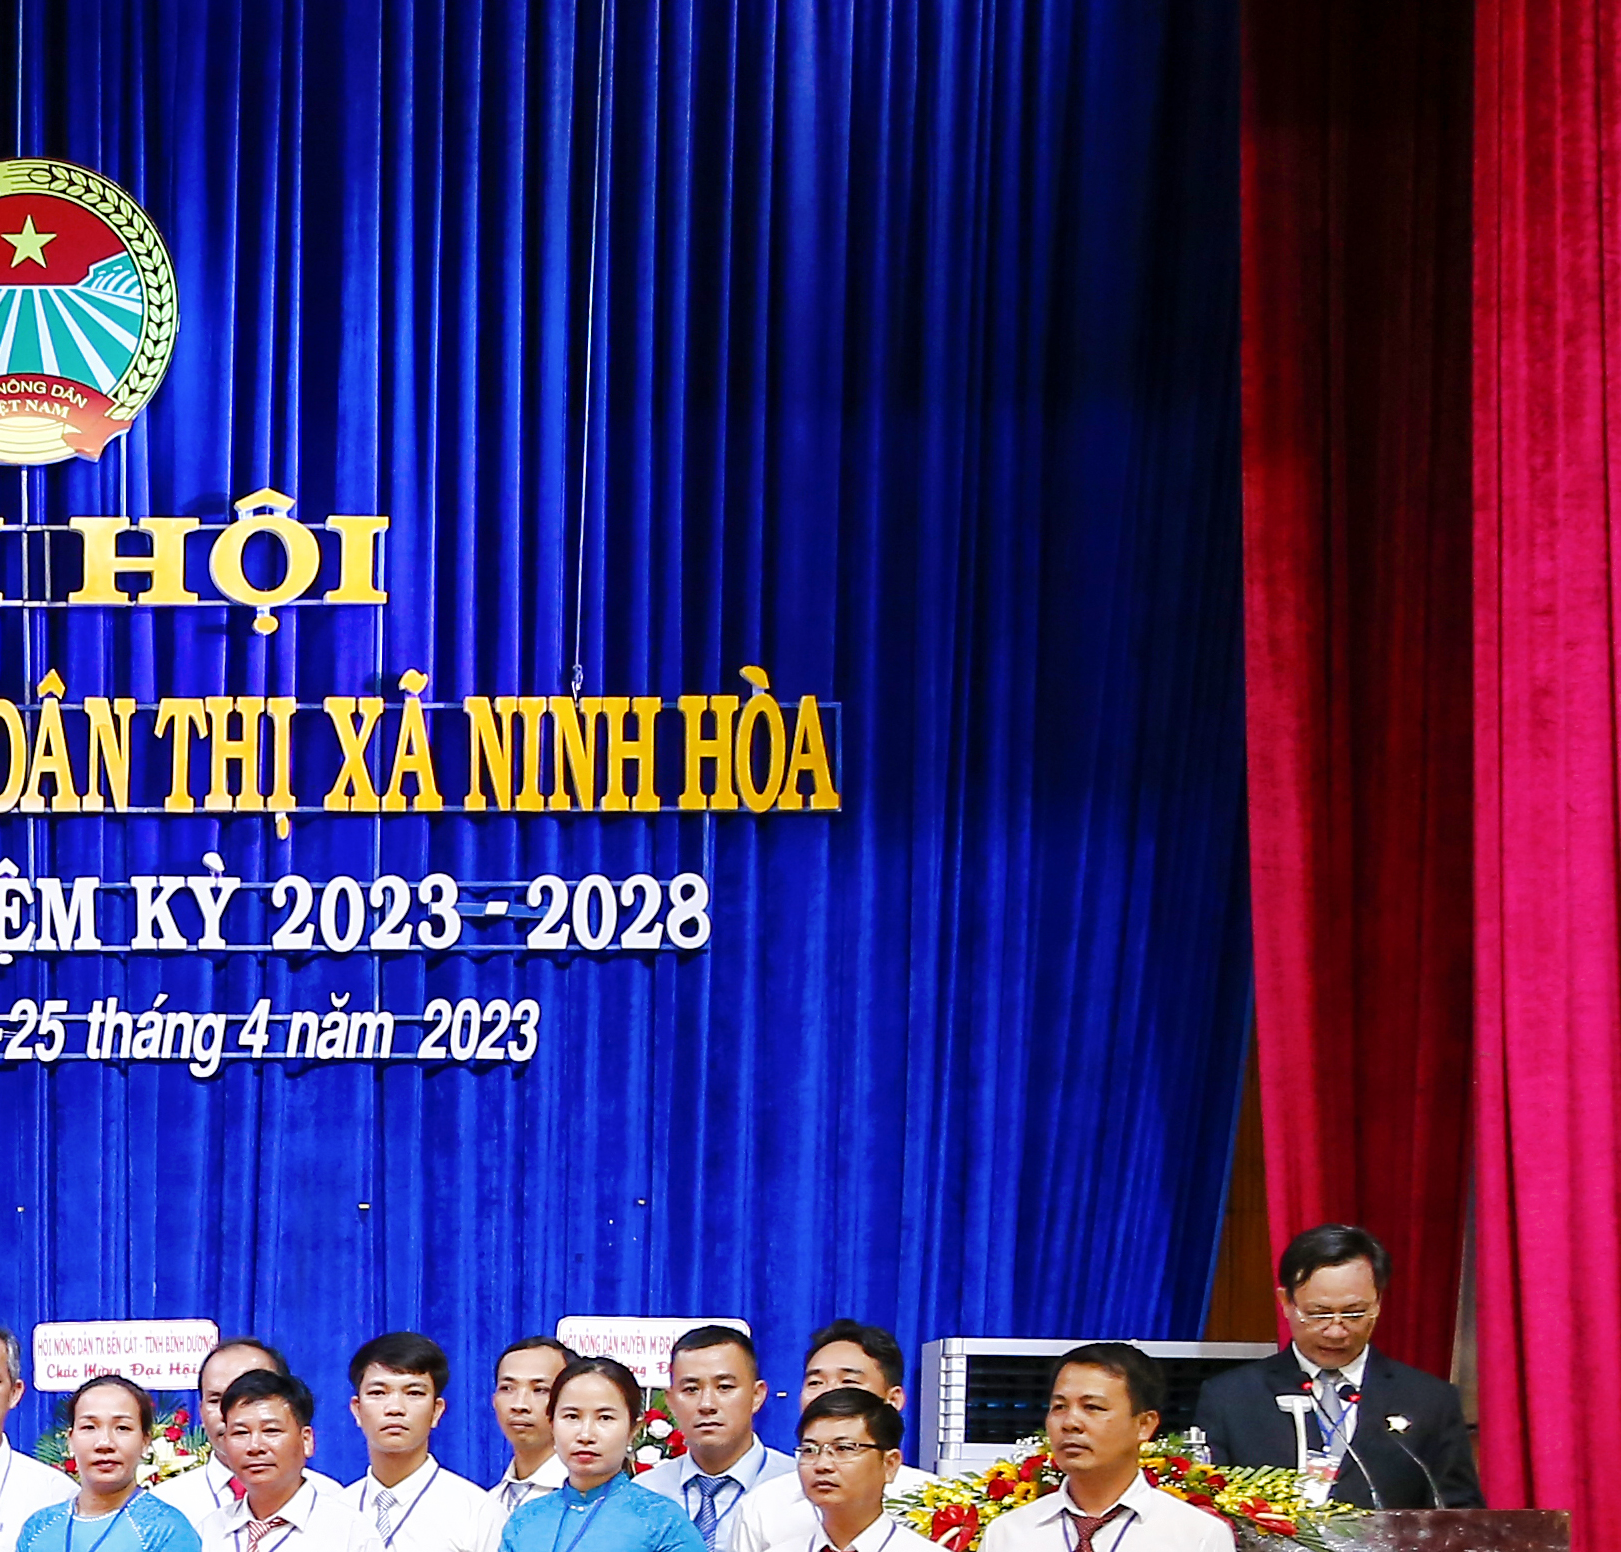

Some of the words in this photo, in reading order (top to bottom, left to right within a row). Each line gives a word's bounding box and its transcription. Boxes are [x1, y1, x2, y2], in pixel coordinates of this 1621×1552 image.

[24, 399, 71, 419] NAM
[50, 384, 89, 409] DÂN
[68, 487, 390, 635] HỘI
[154, 696, 297, 840] THỊ
[323, 668, 444, 812] XÃ
[464, 695, 662, 812] NINH
[678, 665, 840, 814] HÒA
[130, 851, 241, 952] KỲ
[271, 873, 462, 953] 2023
[526, 872, 711, 951] 2028
[84, 993, 227, 1078] tháng
[238, 998, 272, 1060] 4
[286, 991, 396, 1060] năm
[417, 998, 542, 1062] 2023
[54, 1332, 76, 1356] NÔNG
[78, 1331, 94, 1356] DÂN
[579, 1328, 601, 1354] NÔNG
[603, 1328, 619, 1354] DÂN
[130, 1363, 163, 1379] Đại
[168, 1362, 199, 1379] Hội
